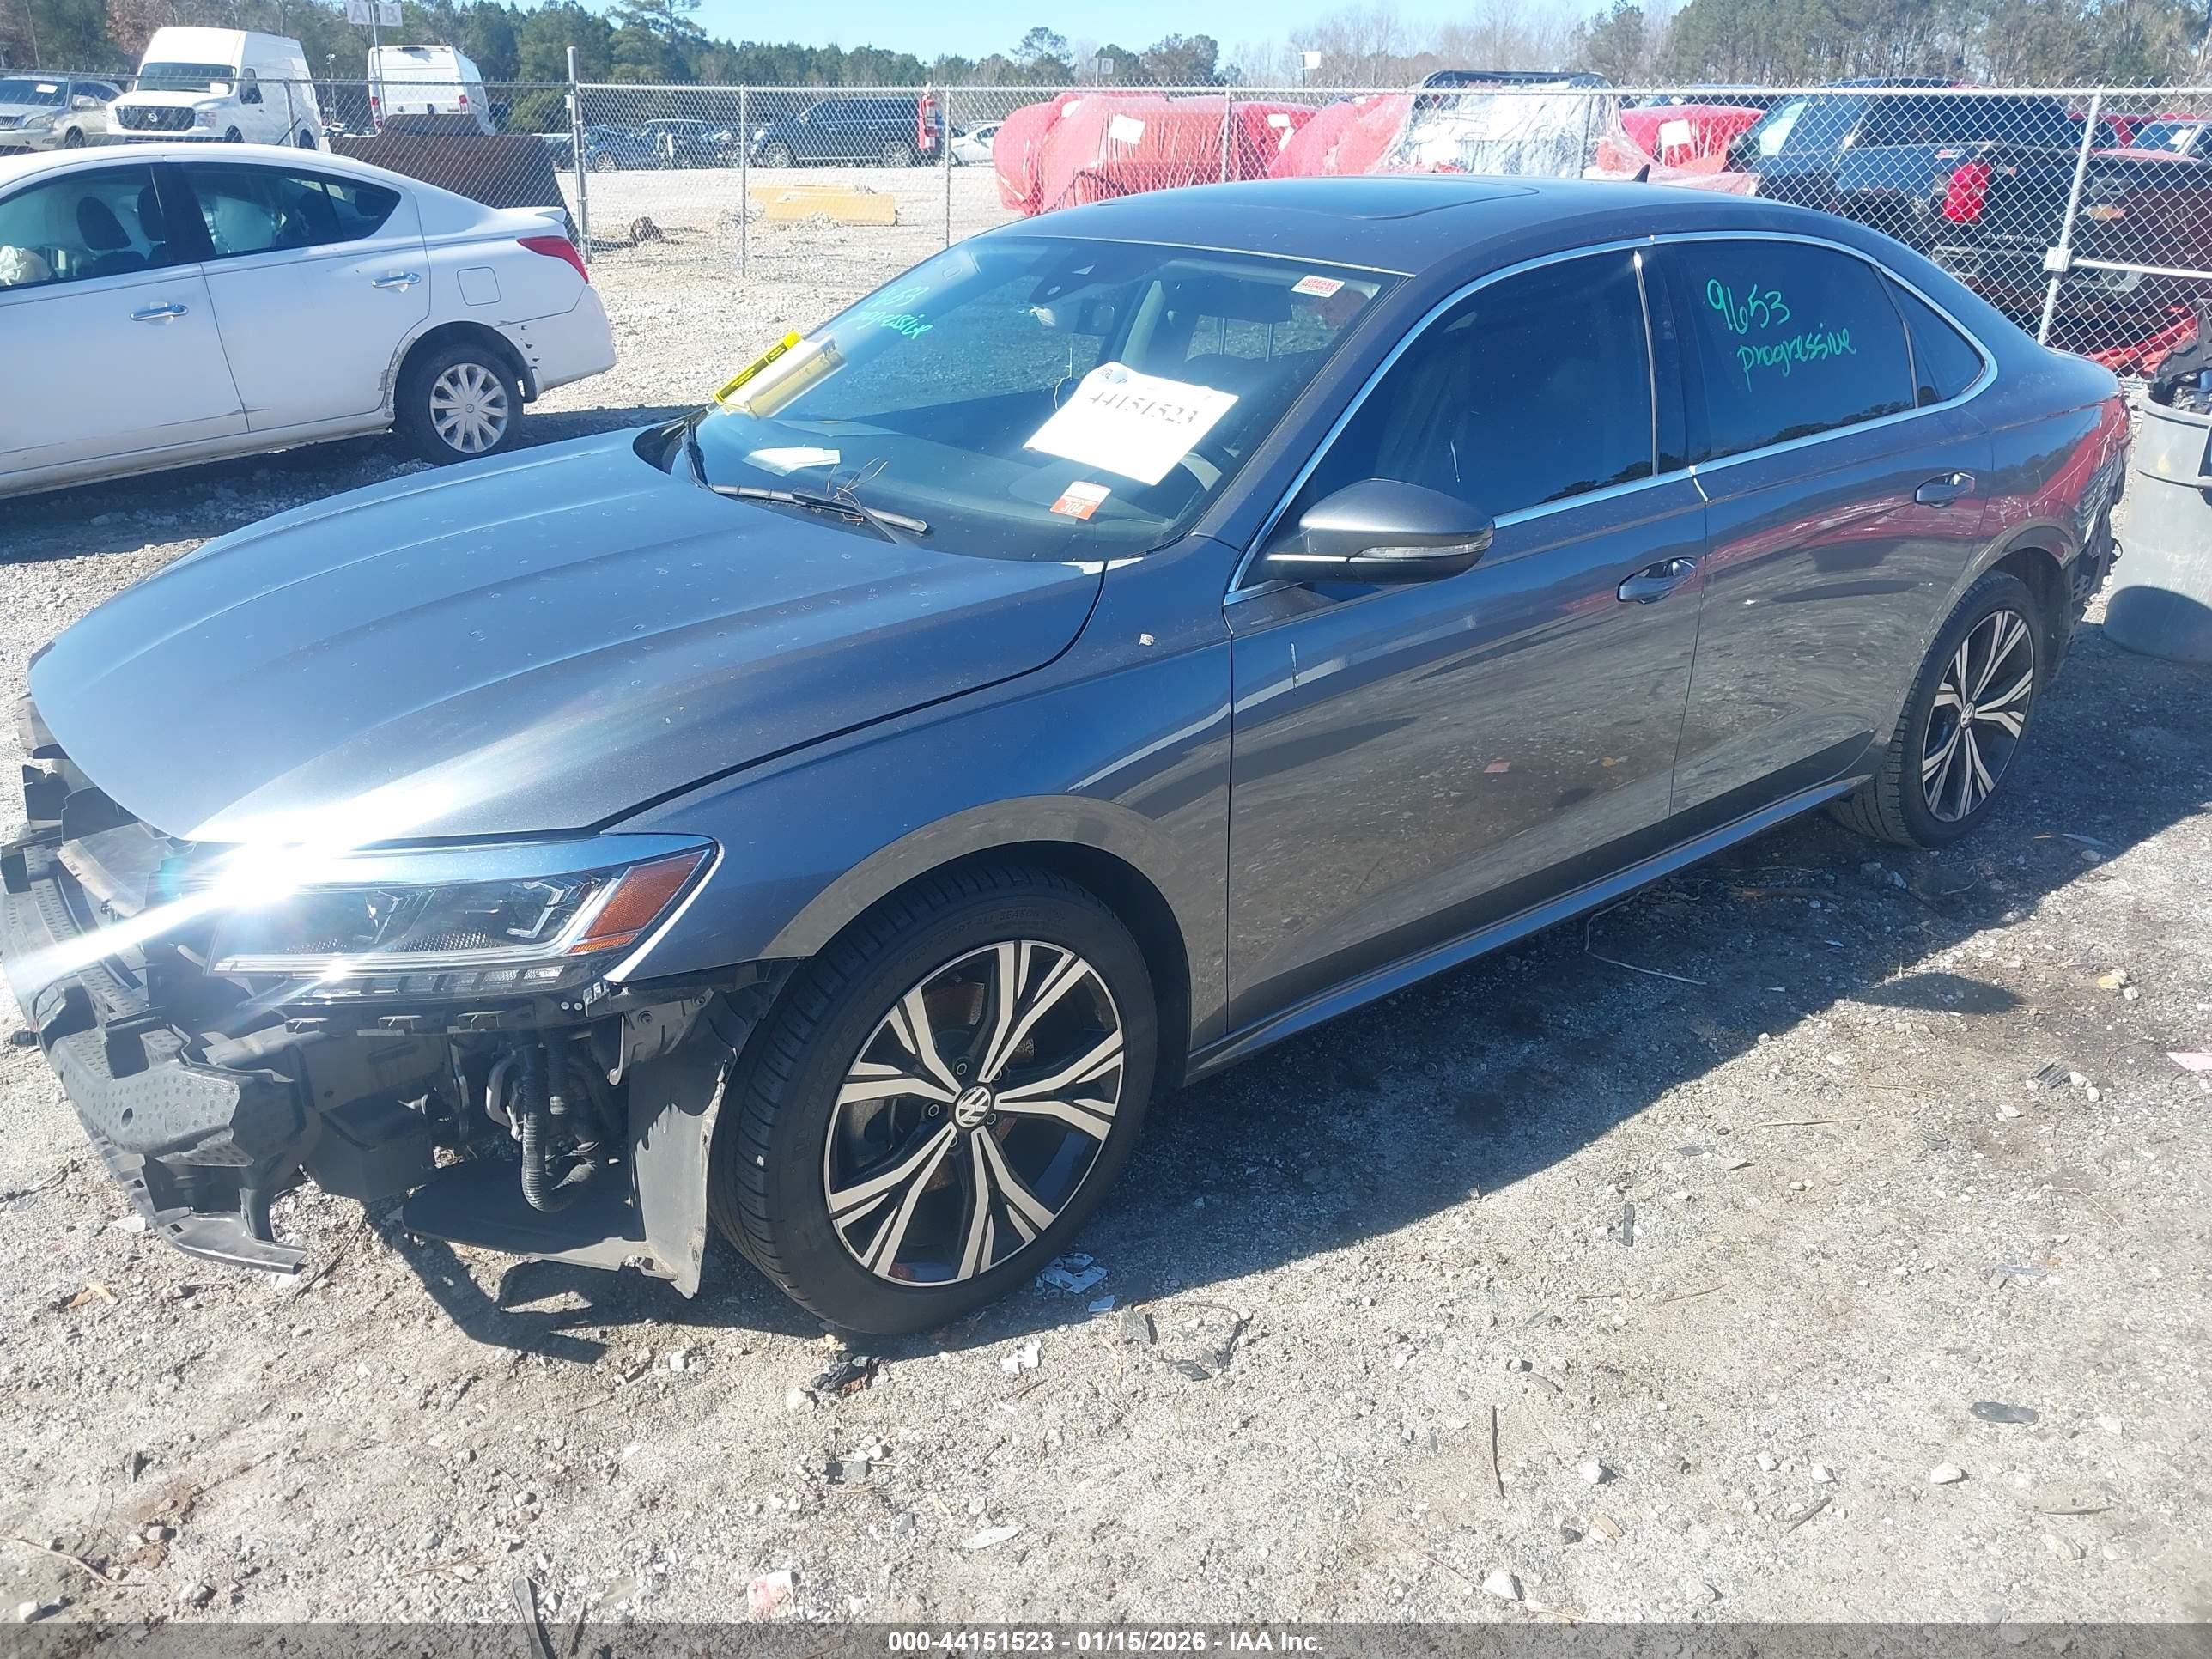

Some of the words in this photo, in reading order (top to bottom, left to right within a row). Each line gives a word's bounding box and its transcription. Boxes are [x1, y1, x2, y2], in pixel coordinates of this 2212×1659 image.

[351, 3, 368, 21] A
[384, 5, 398, 22] B
[1707, 279, 1790, 335] 9653
[1737, 322, 1856, 392] progressive
[1060, 500, 1086, 515] 304
